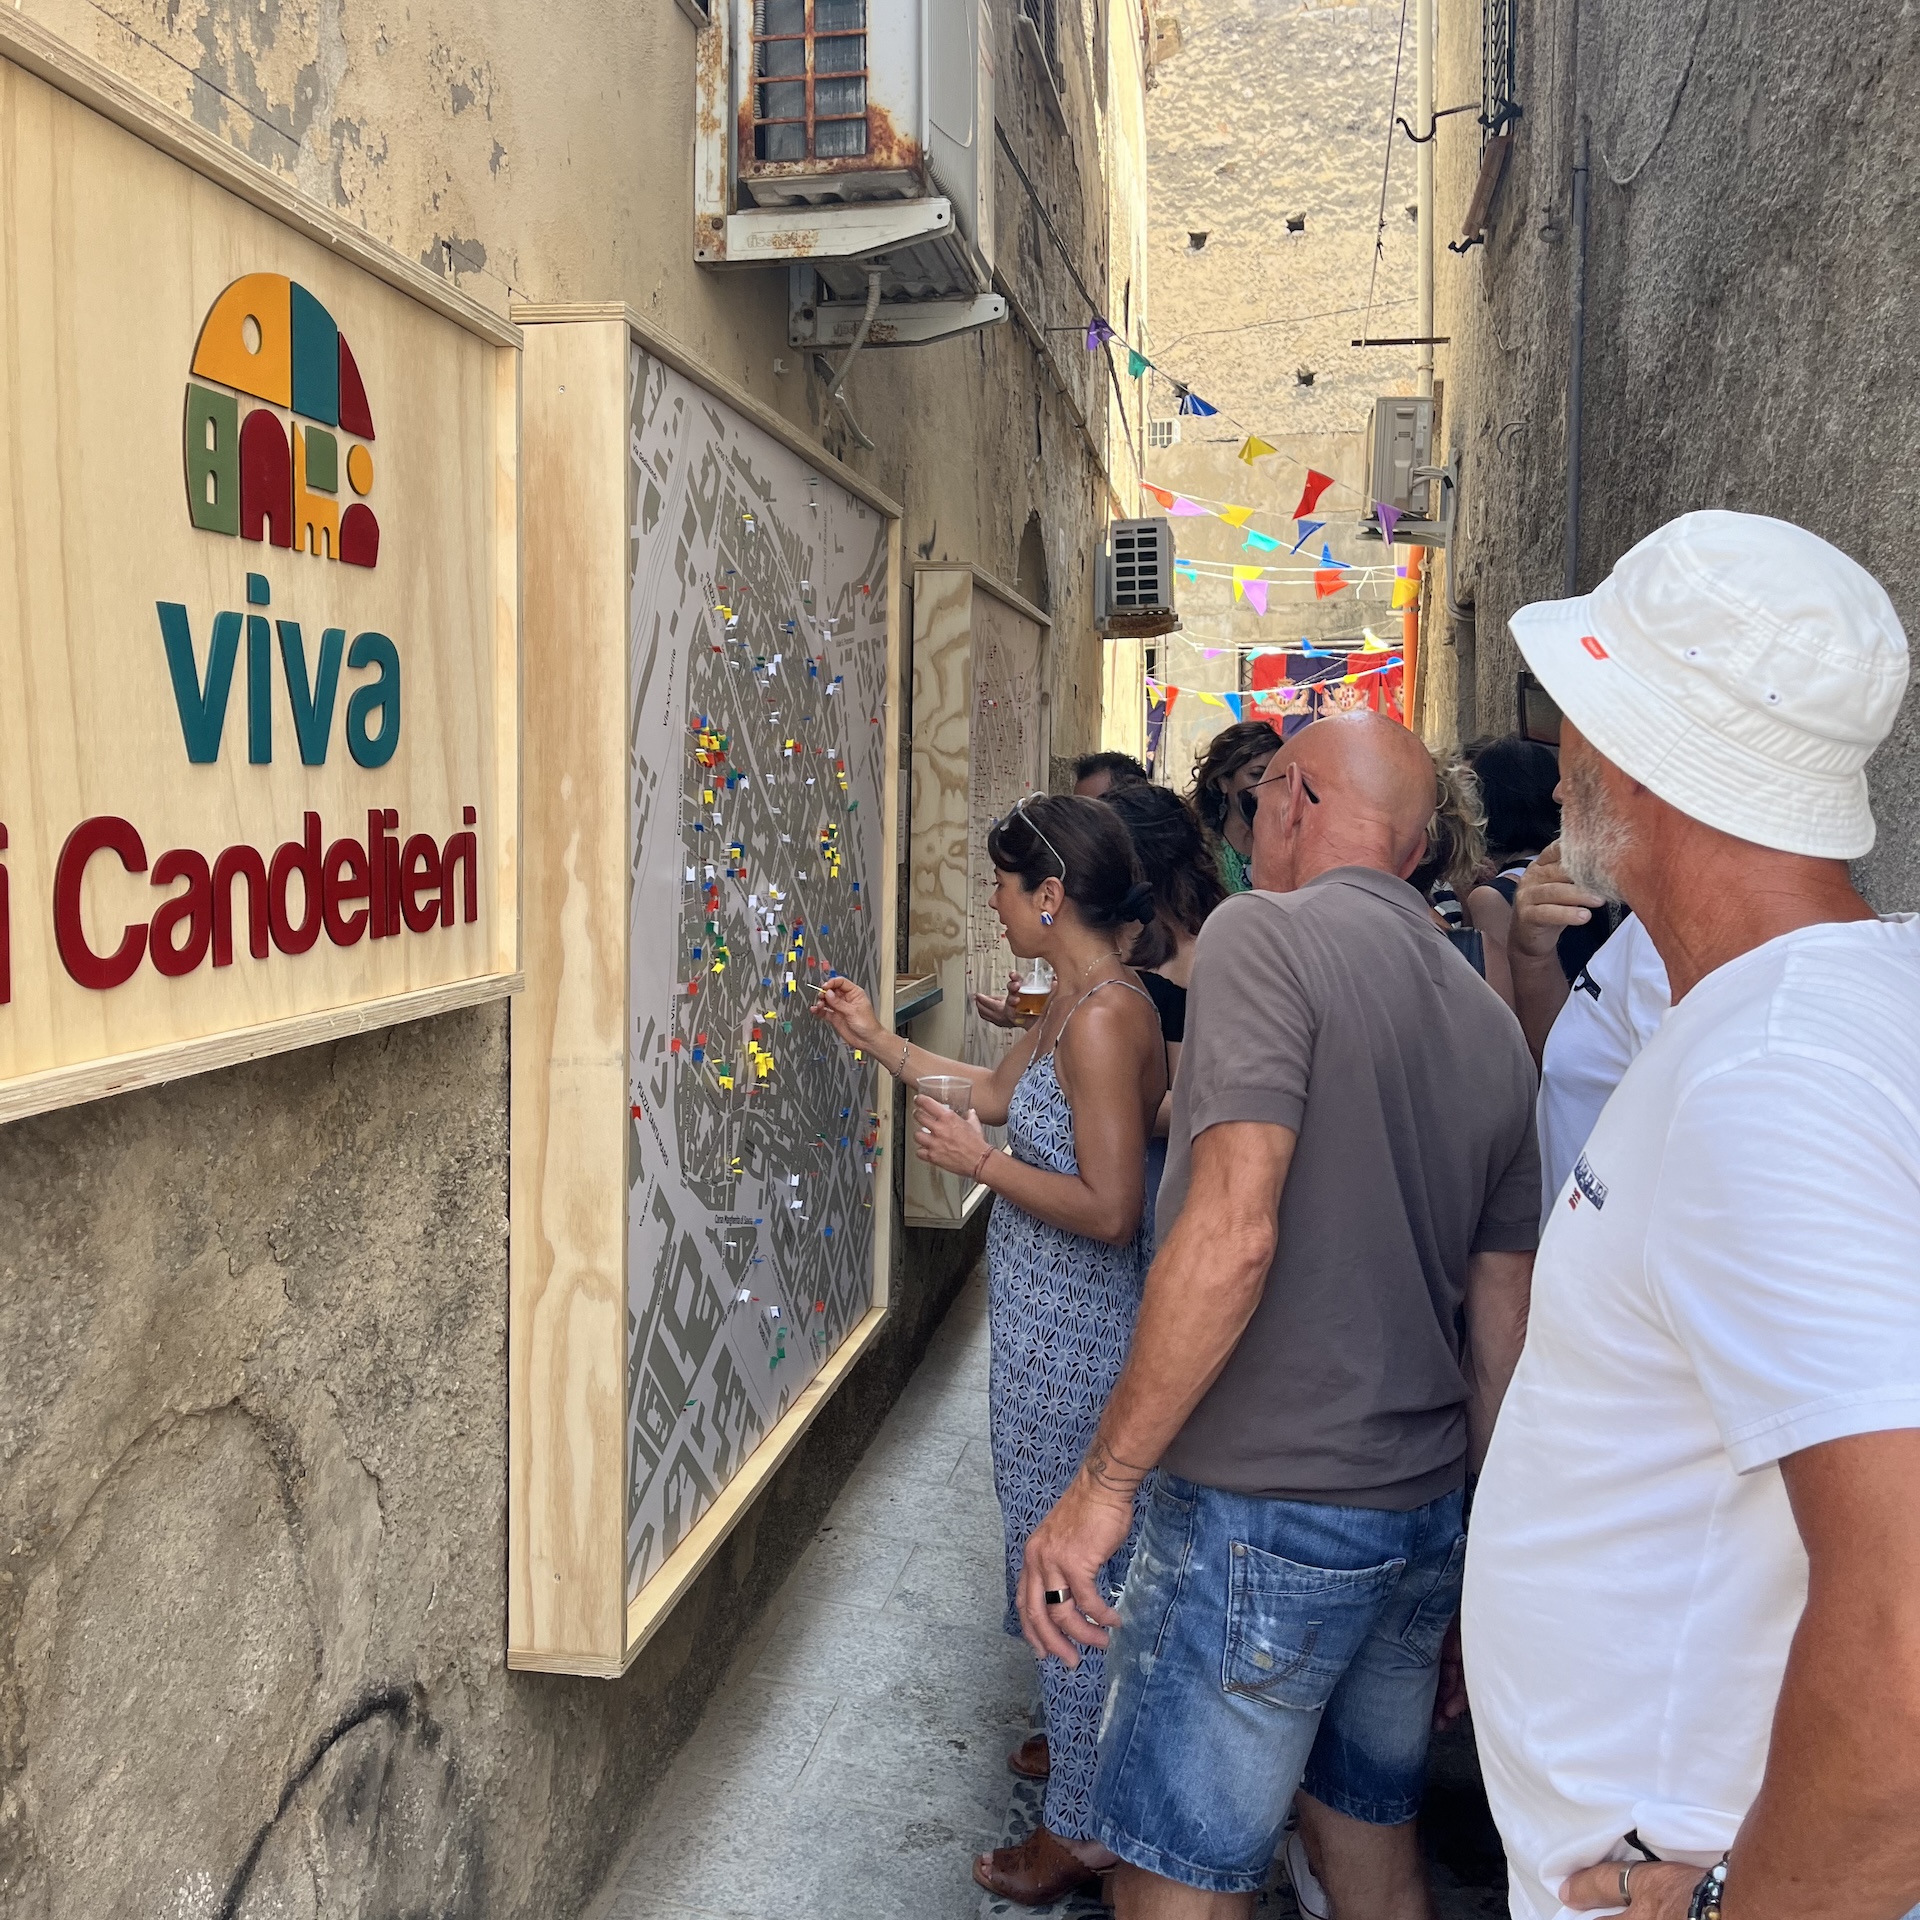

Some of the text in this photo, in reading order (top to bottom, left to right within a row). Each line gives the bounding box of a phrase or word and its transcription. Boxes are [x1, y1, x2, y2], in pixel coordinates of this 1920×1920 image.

[156, 573, 400, 769] viva
[54, 806, 478, 989] Candelieri
[637, 1081, 650, 1116] PIAZZA
